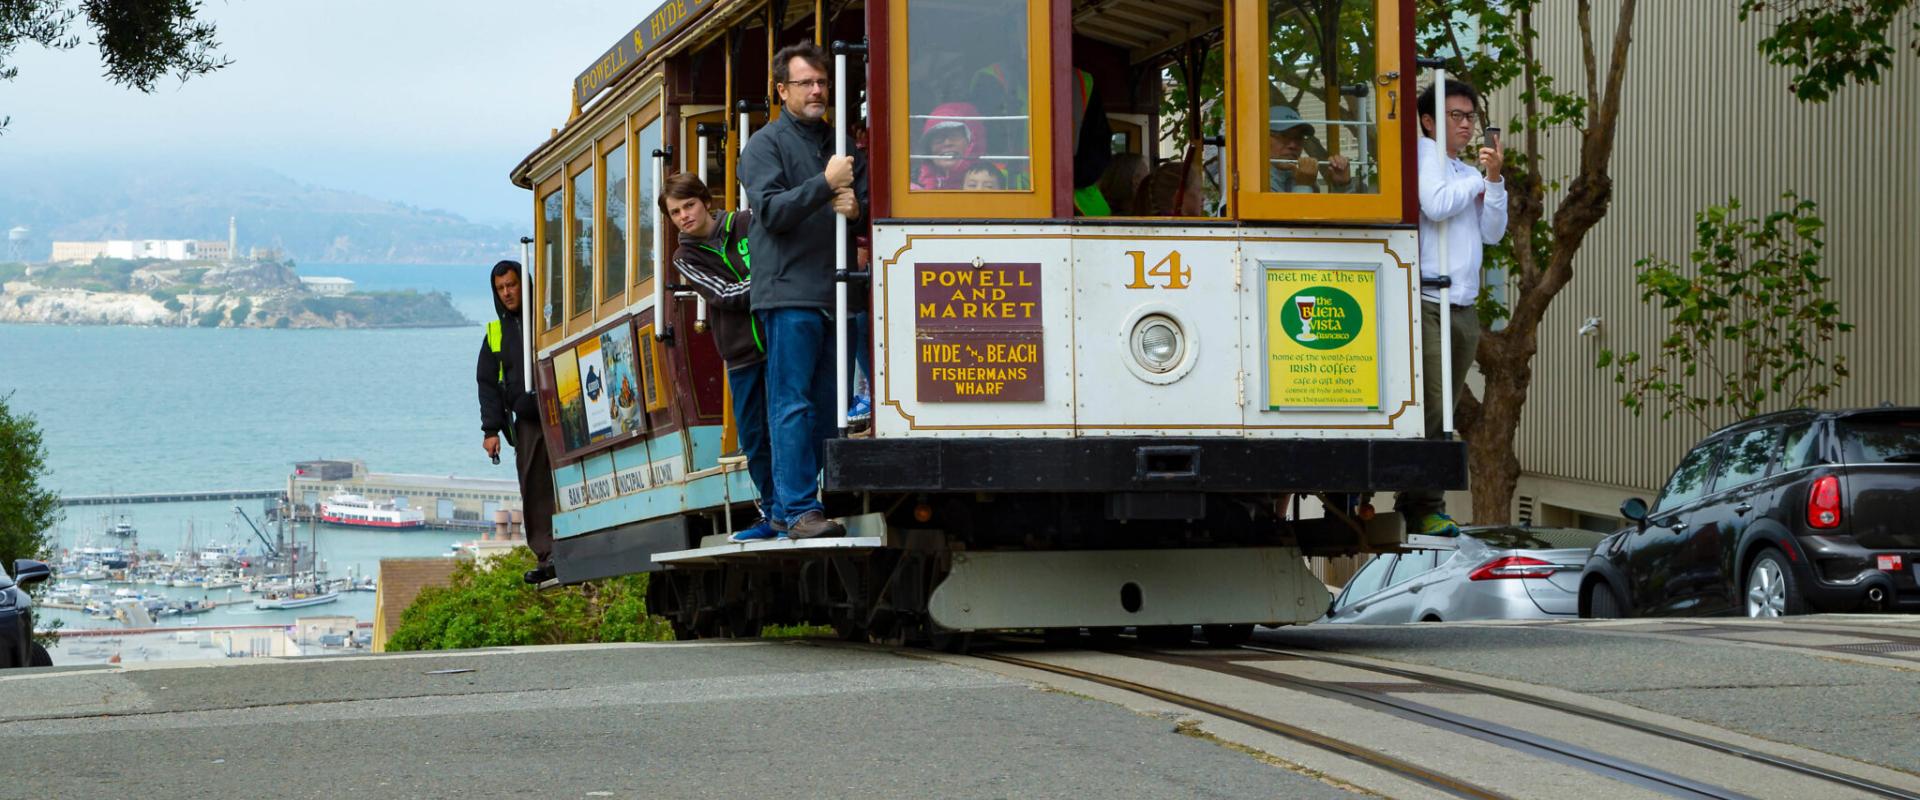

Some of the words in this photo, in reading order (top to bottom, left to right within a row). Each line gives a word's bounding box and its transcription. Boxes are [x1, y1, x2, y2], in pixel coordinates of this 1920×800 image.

[581, 47, 628, 97] POWELL
[633, 29, 645, 55] &
[650, 0, 687, 40] HYDE
[1124, 250, 1192, 289] 14
[921, 270, 1033, 287] POWELL
[951, 288, 1006, 301] AND
[1316, 296, 1333, 305] the
[920, 302, 1036, 318] MARKET
[922, 344, 961, 363] HYDE
[965, 344, 984, 363] AND
[986, 344, 1037, 363] BEACH
[932, 367, 1028, 380] FISHERMANS
[955, 382, 1004, 395] WHARF
[568, 486, 581, 506] SAN
